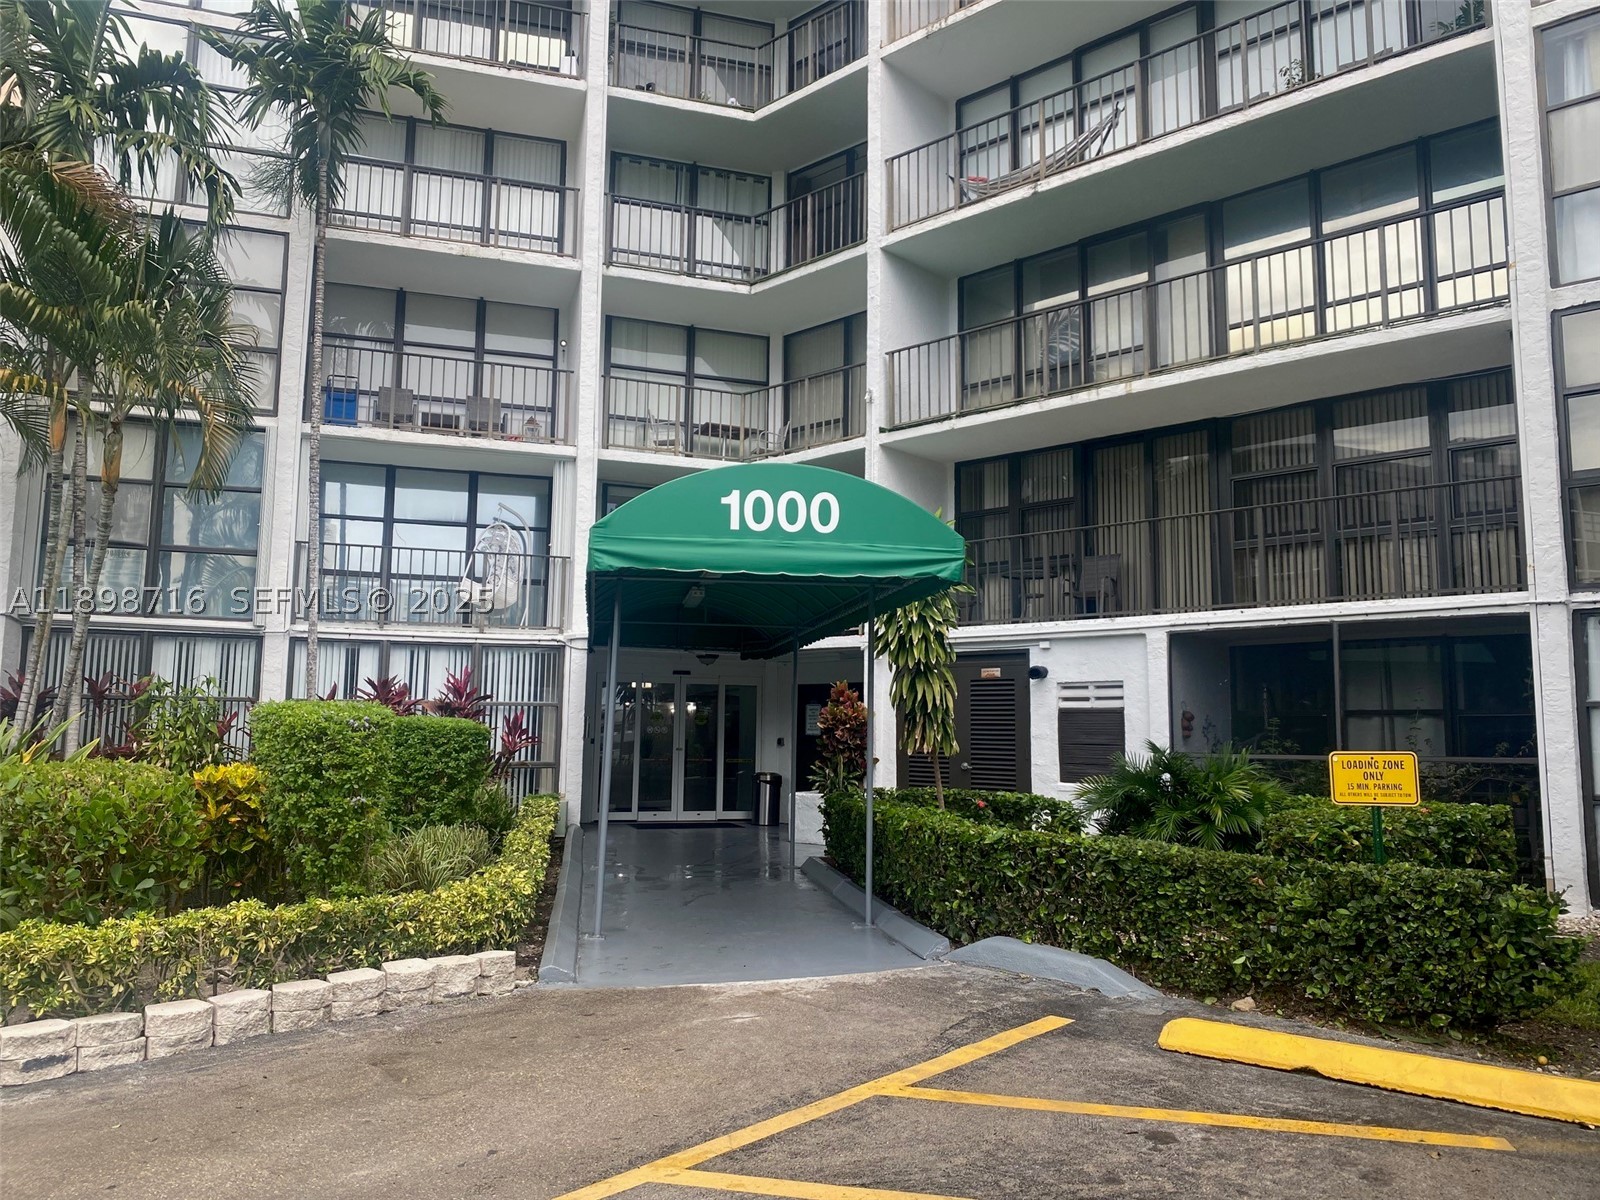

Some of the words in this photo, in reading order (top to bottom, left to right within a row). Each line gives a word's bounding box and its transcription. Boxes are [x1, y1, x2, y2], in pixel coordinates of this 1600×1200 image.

[720, 489, 840, 534] 1000
[1341, 760, 1379, 769] LOADING
[1383, 760, 1405, 769] ZONE
[1363, 771, 1384, 780] ONLY
[1373, 783, 1403, 791] PARKING
